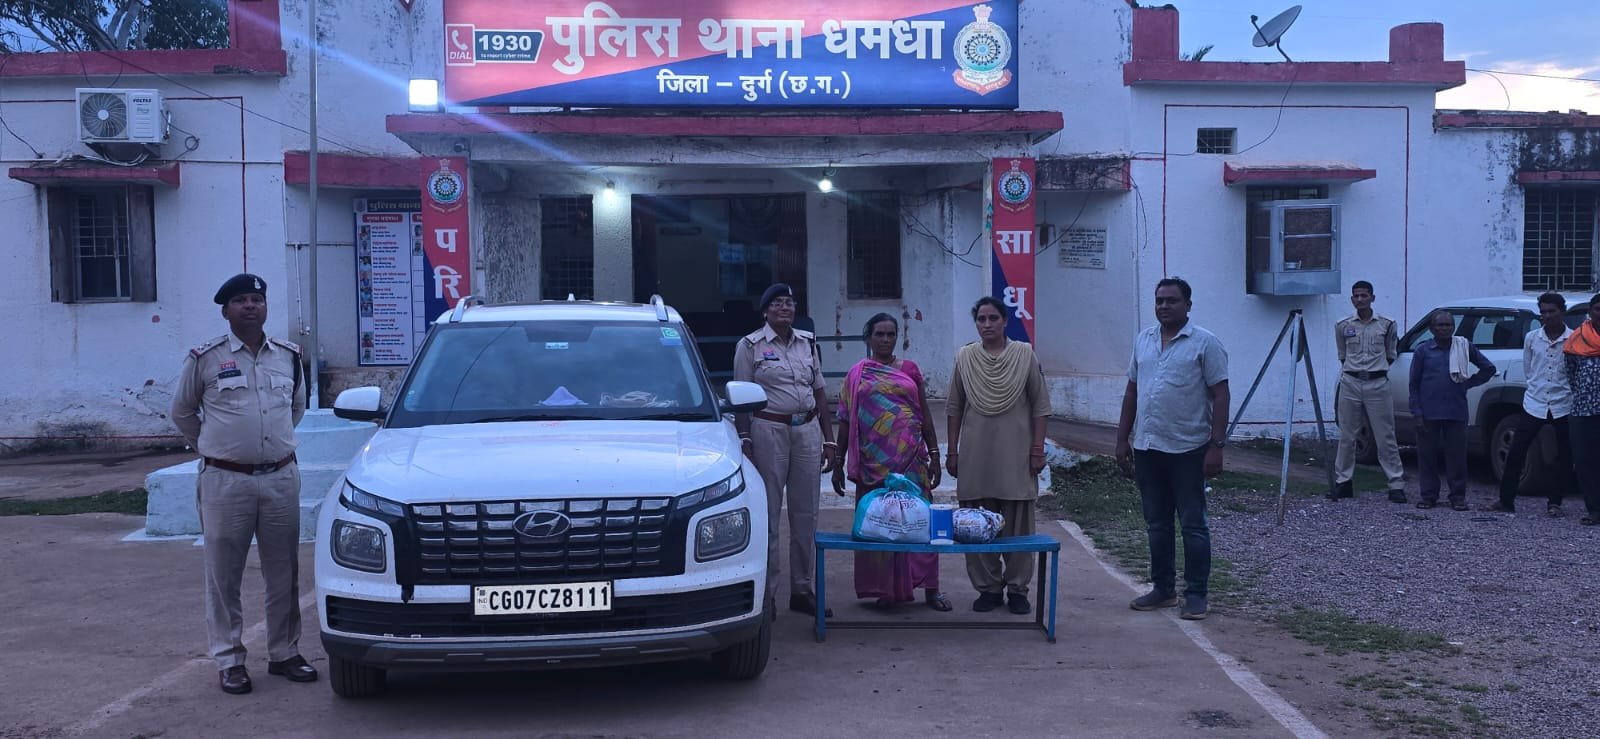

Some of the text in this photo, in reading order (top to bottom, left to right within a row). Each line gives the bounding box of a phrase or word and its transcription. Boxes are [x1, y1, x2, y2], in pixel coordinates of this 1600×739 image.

[478, 34, 532, 51] 1930
[545, 1, 945, 76] पुलिस थाना धमधा
[449, 51, 472, 60] DIAL
[656, 68, 710, 93] जिला
[739, 69, 772, 101] दुर्ग
[778, 70, 851, 99] (छ.ग.)
[489, 586, 609, 610] CG07CZ8111
